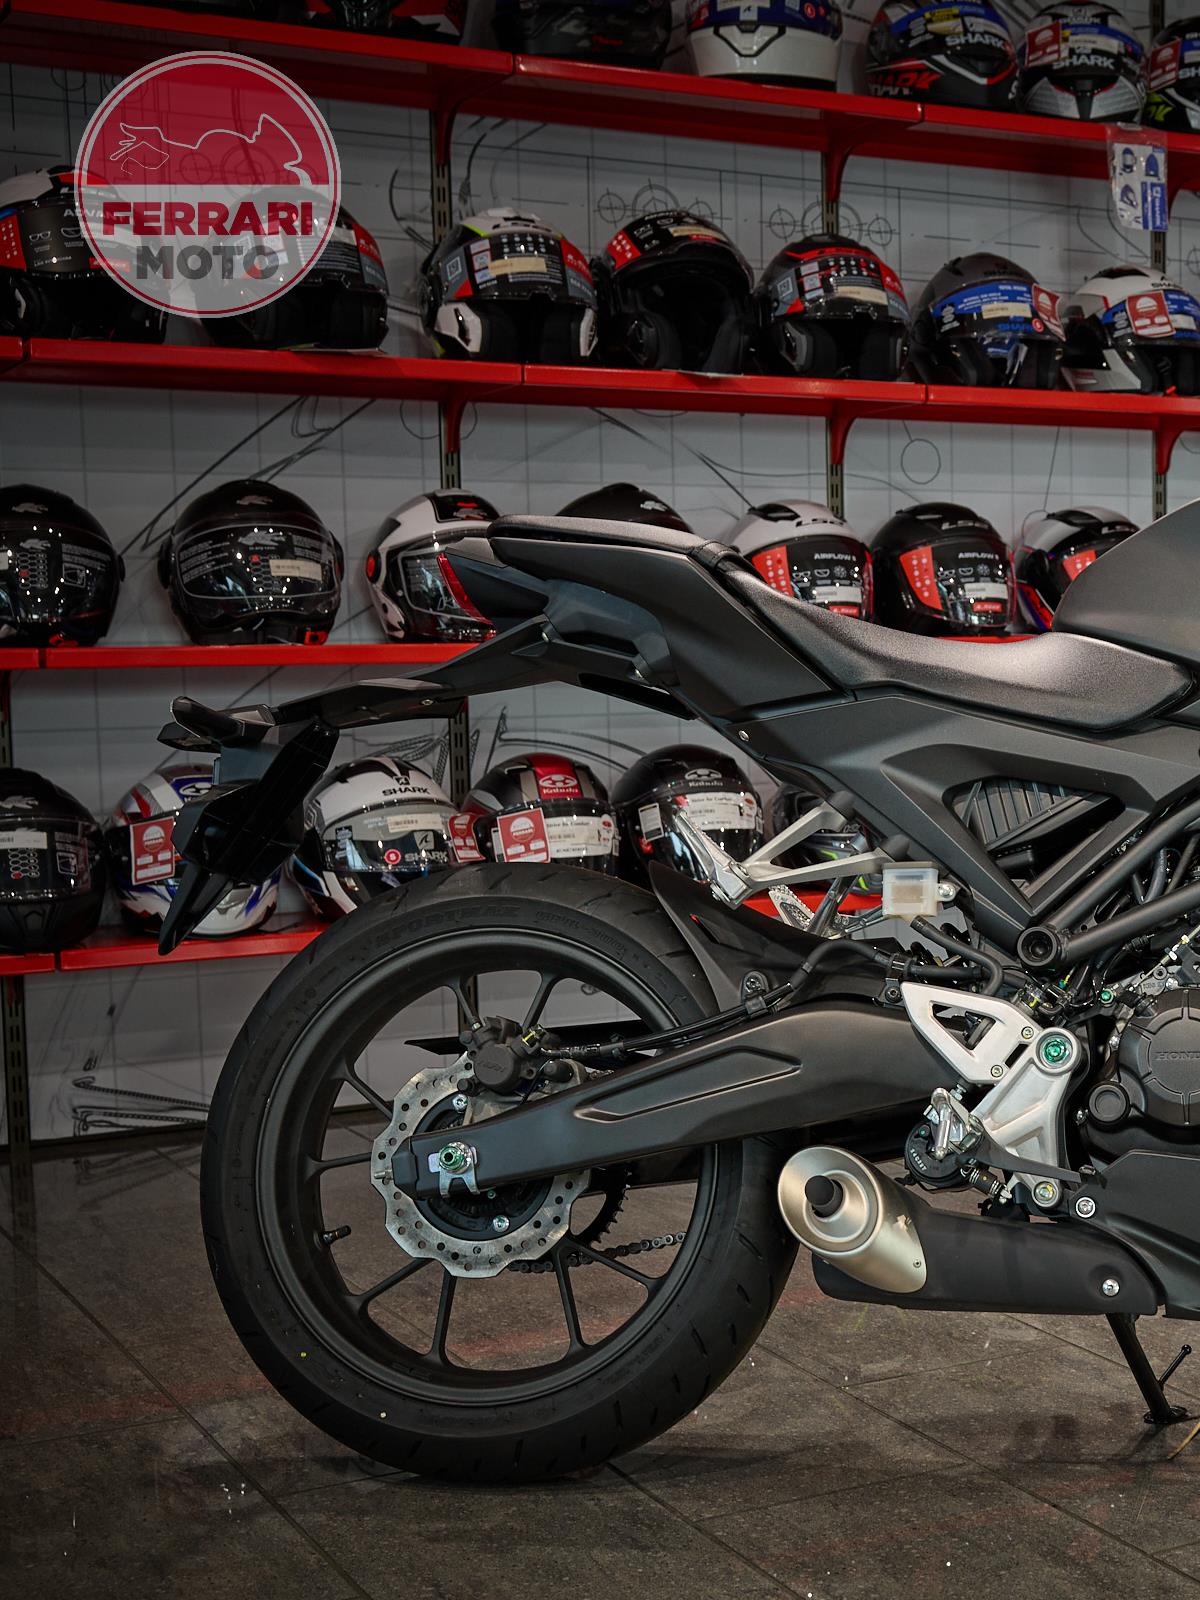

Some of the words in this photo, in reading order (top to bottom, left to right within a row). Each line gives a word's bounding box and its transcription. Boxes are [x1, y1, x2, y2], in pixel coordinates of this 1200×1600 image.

[944, 31, 1006, 50] SHARK
[1052, 53, 1116, 71] SHARK
[814, 552, 851, 561] AIRFLOW
[382, 786, 431, 797] SHARK
[404, 850, 448, 863] SHARK
